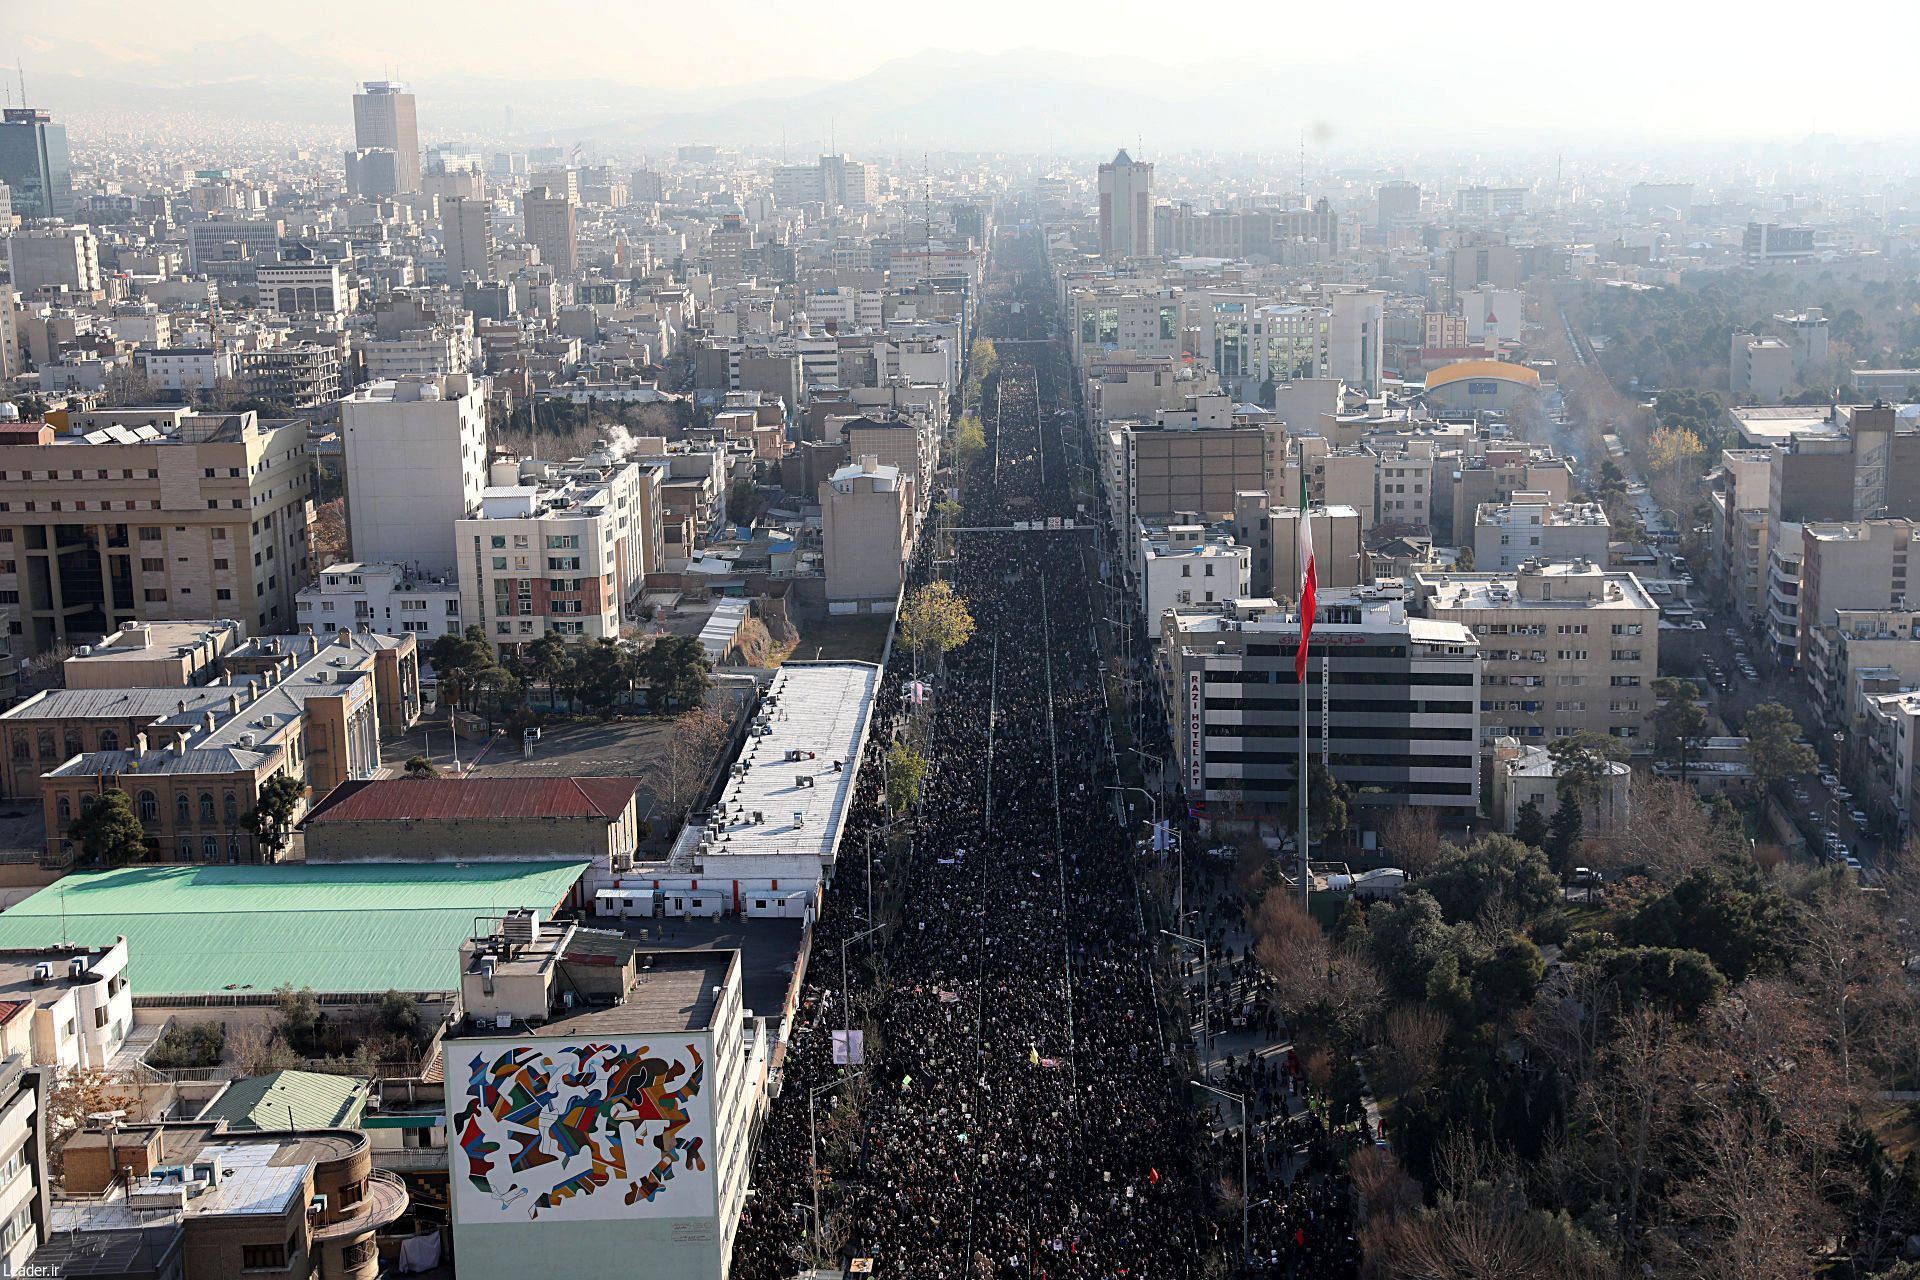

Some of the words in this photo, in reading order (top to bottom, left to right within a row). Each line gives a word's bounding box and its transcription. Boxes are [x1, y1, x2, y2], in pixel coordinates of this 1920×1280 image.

[1377, 583, 1403, 591] هتل
[1344, 633, 1365, 645] هتل
[1191, 675, 1199, 709] RAZI
[1191, 713, 1200, 756] HOTEL
[1192, 761, 1200, 784] APT
